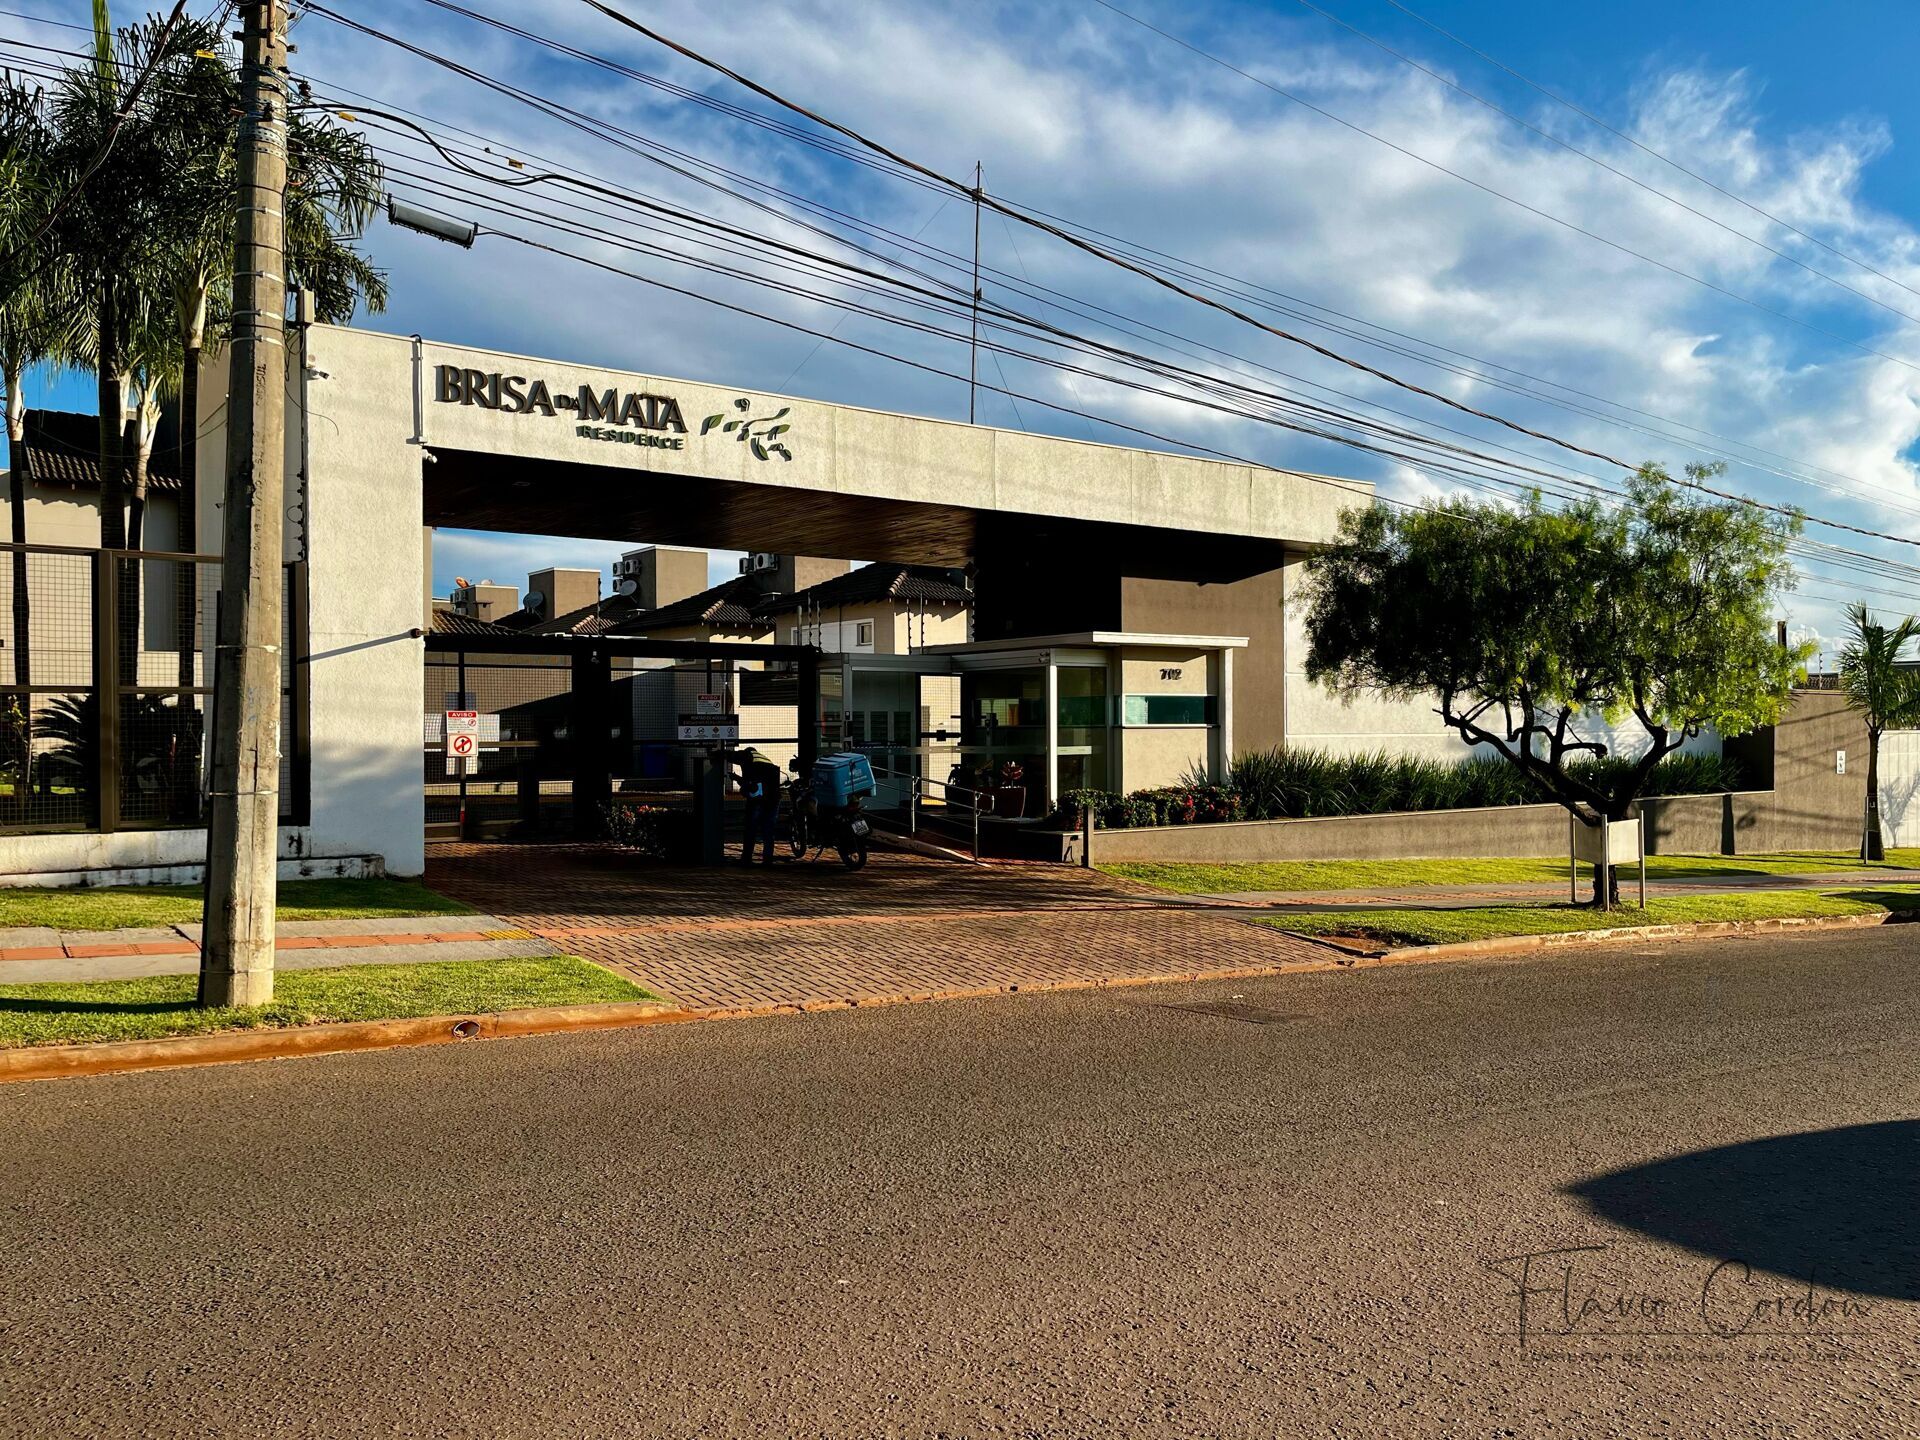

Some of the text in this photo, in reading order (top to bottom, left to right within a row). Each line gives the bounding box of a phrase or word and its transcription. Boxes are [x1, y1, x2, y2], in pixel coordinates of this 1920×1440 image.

[433, 364, 689, 433] BRISA DA MATA
[576, 425, 684, 450] RESIDENCE
